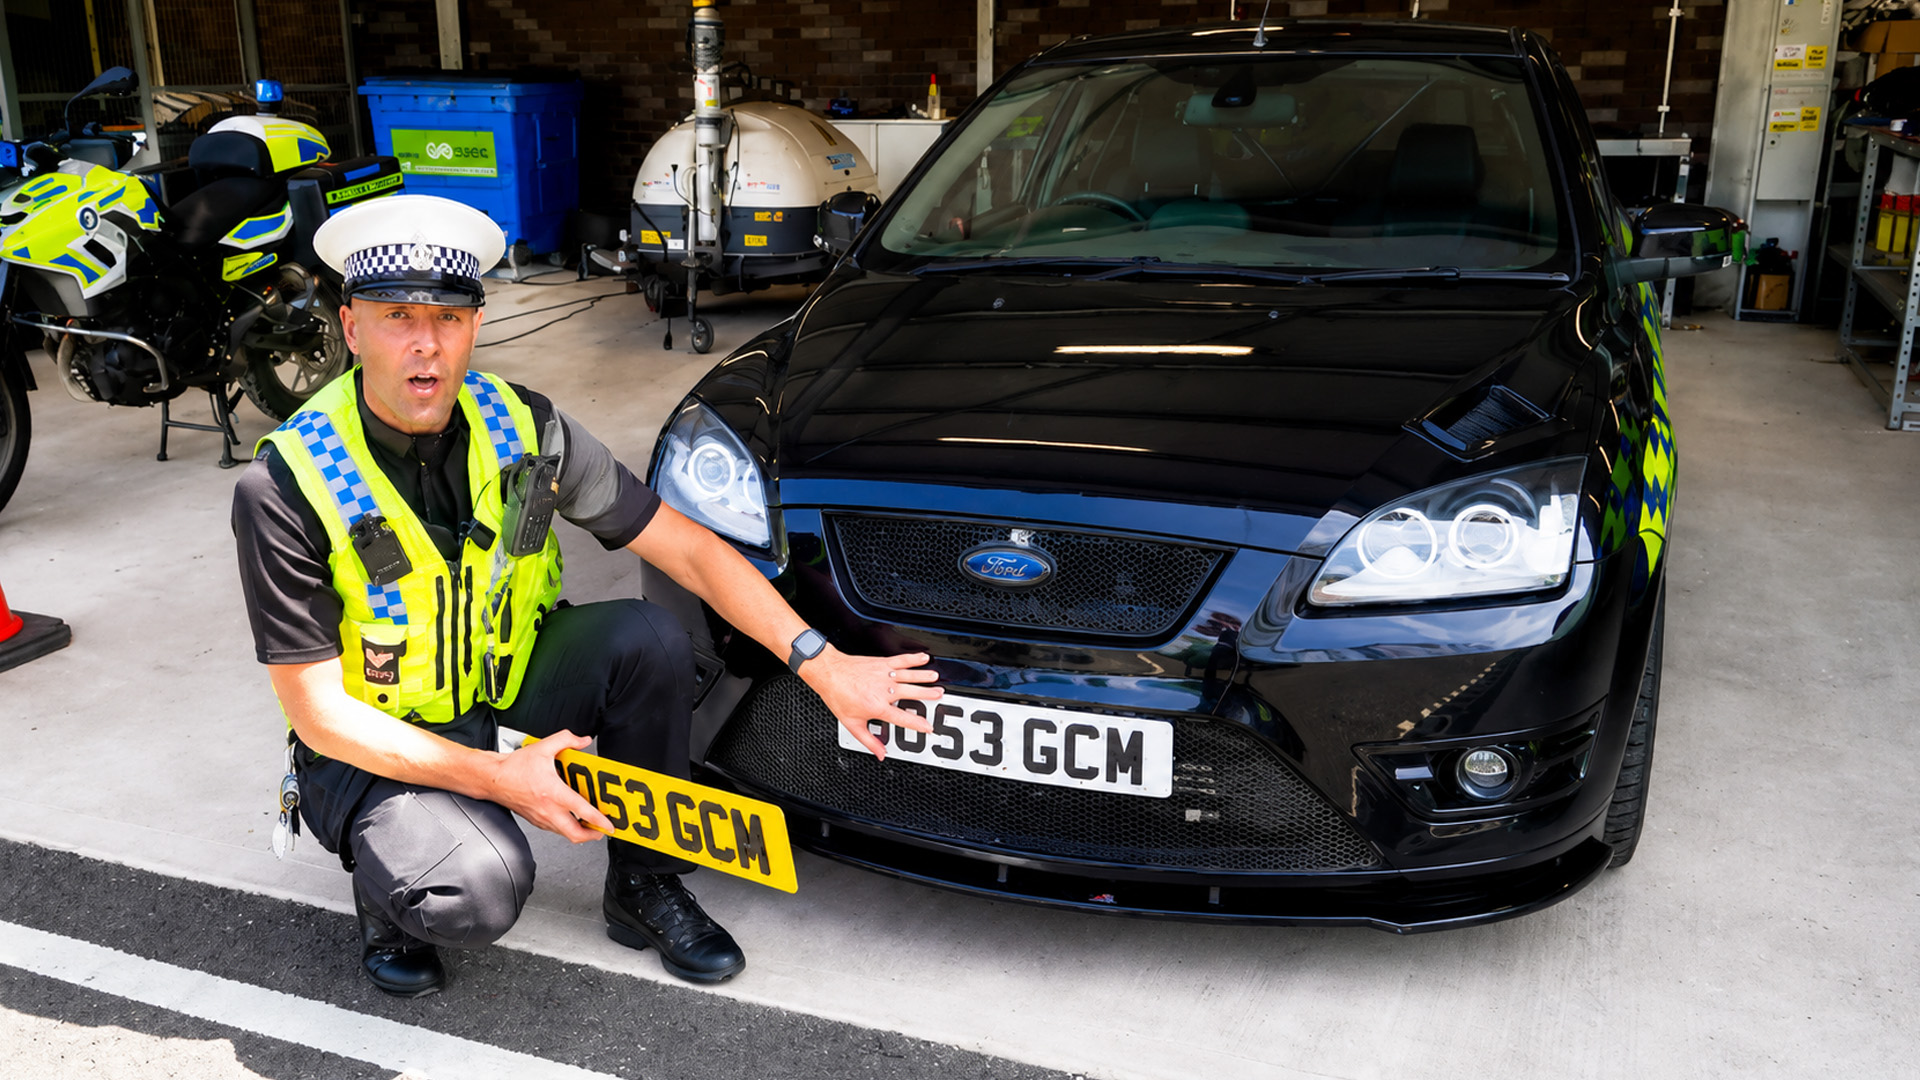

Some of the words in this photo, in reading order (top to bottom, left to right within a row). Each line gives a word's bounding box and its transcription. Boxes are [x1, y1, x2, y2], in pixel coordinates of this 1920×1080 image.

[981, 556, 1028, 577] Ford
[1023, 717, 1144, 786] GCM
[555, 759, 660, 841] O53
[666, 791, 771, 876] GCM
